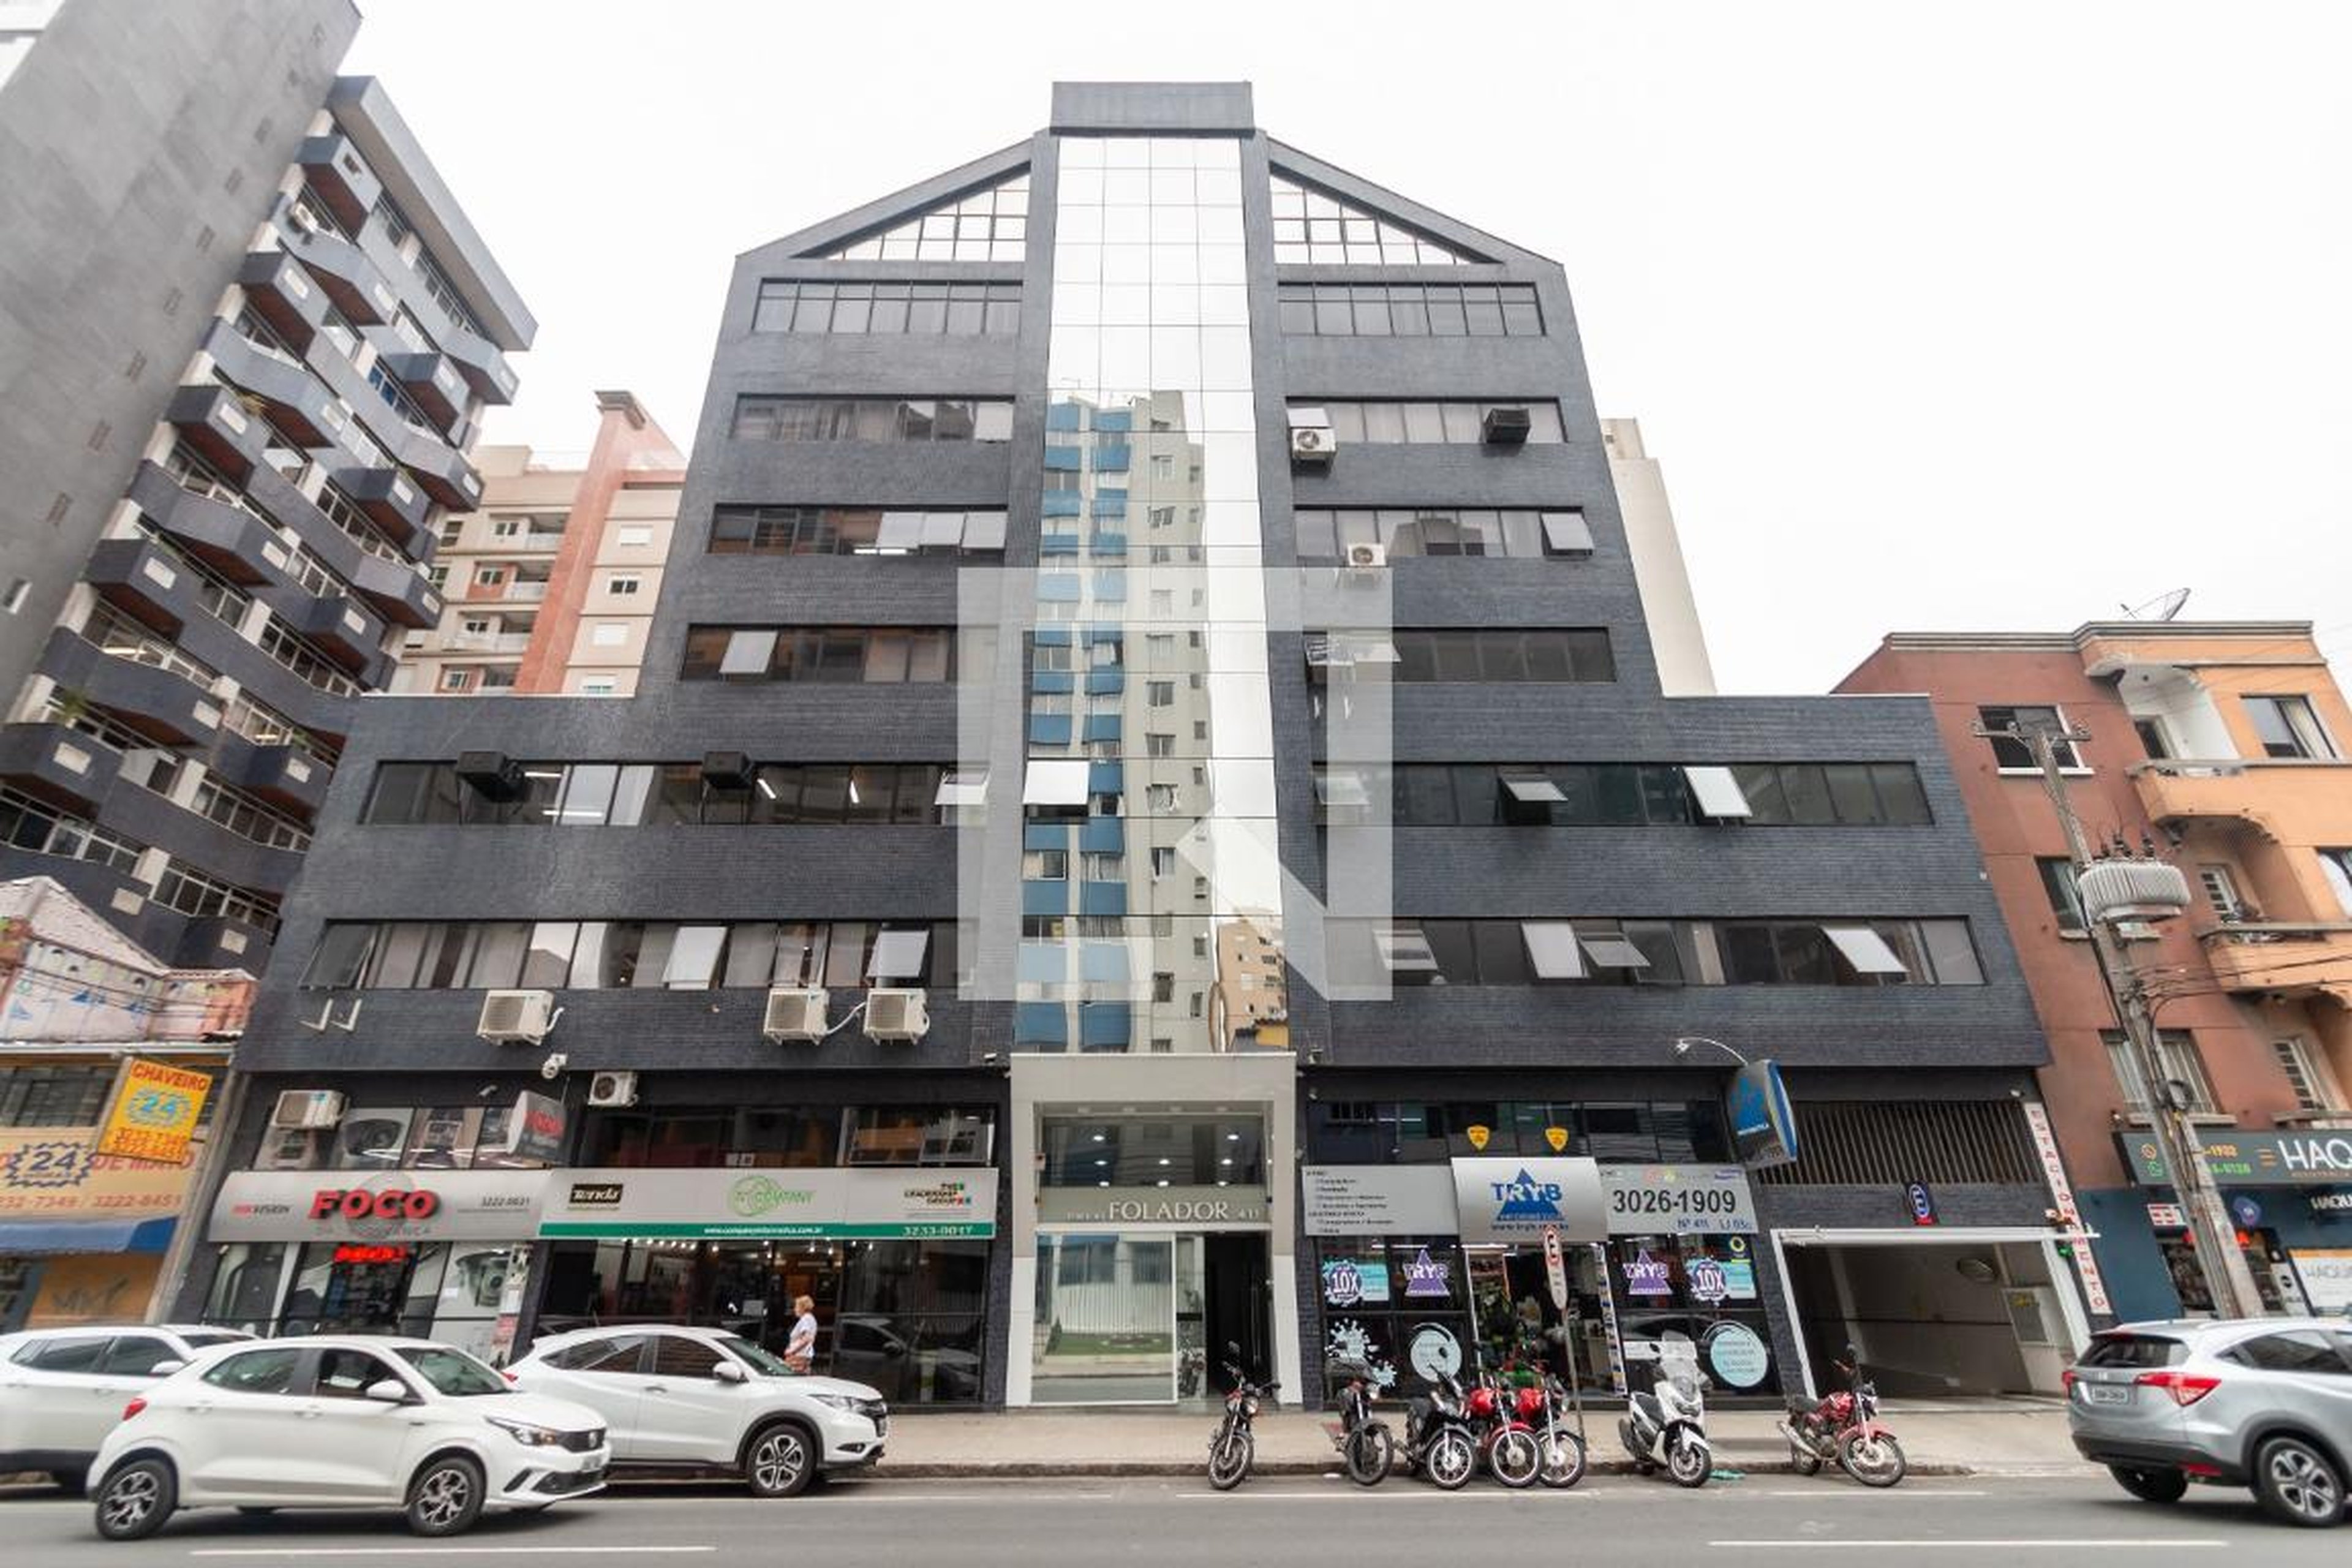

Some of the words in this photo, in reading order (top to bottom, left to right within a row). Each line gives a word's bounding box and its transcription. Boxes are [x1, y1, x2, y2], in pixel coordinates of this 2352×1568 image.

[130, 1063, 209, 1091] CHAVEIRO
[29, 1151, 76, 1170] 24
[1491, 1183, 1562, 1202] TRYB
[1613, 1189, 1736, 1213] 3026-1909
[308, 1189, 439, 1219] FOCO
[1109, 1200, 1230, 1219] FOLADOR
